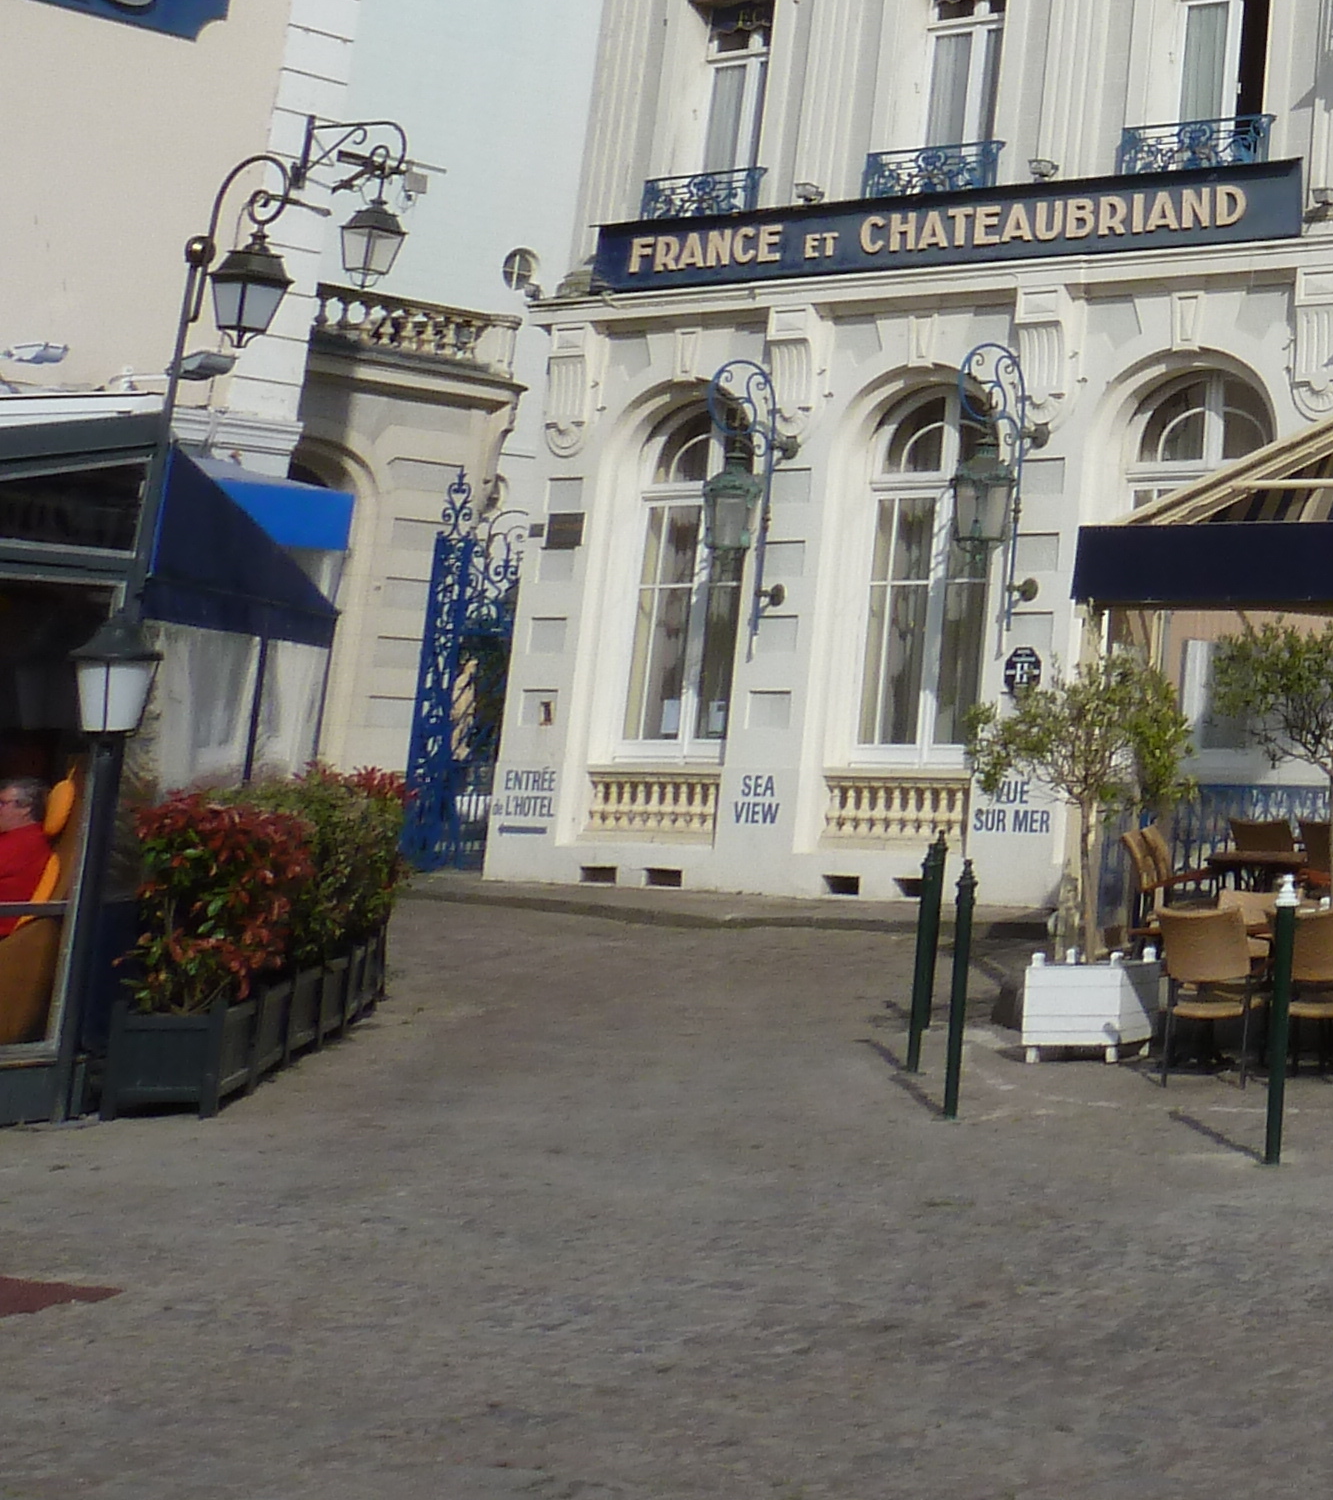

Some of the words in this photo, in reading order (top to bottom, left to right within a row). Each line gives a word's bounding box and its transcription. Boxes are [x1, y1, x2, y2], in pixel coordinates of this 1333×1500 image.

[627, 224, 782, 275] FRANCE
[803, 231, 839, 260] ET
[860, 184, 1247, 255] CHATEAUBRIAND
[504, 765, 557, 791] ENTRÉE
[741, 774, 775, 797] SEA
[733, 801, 780, 824] VIEW
[973, 808, 1006, 832] SUR
[1012, 809, 1050, 833] MER
